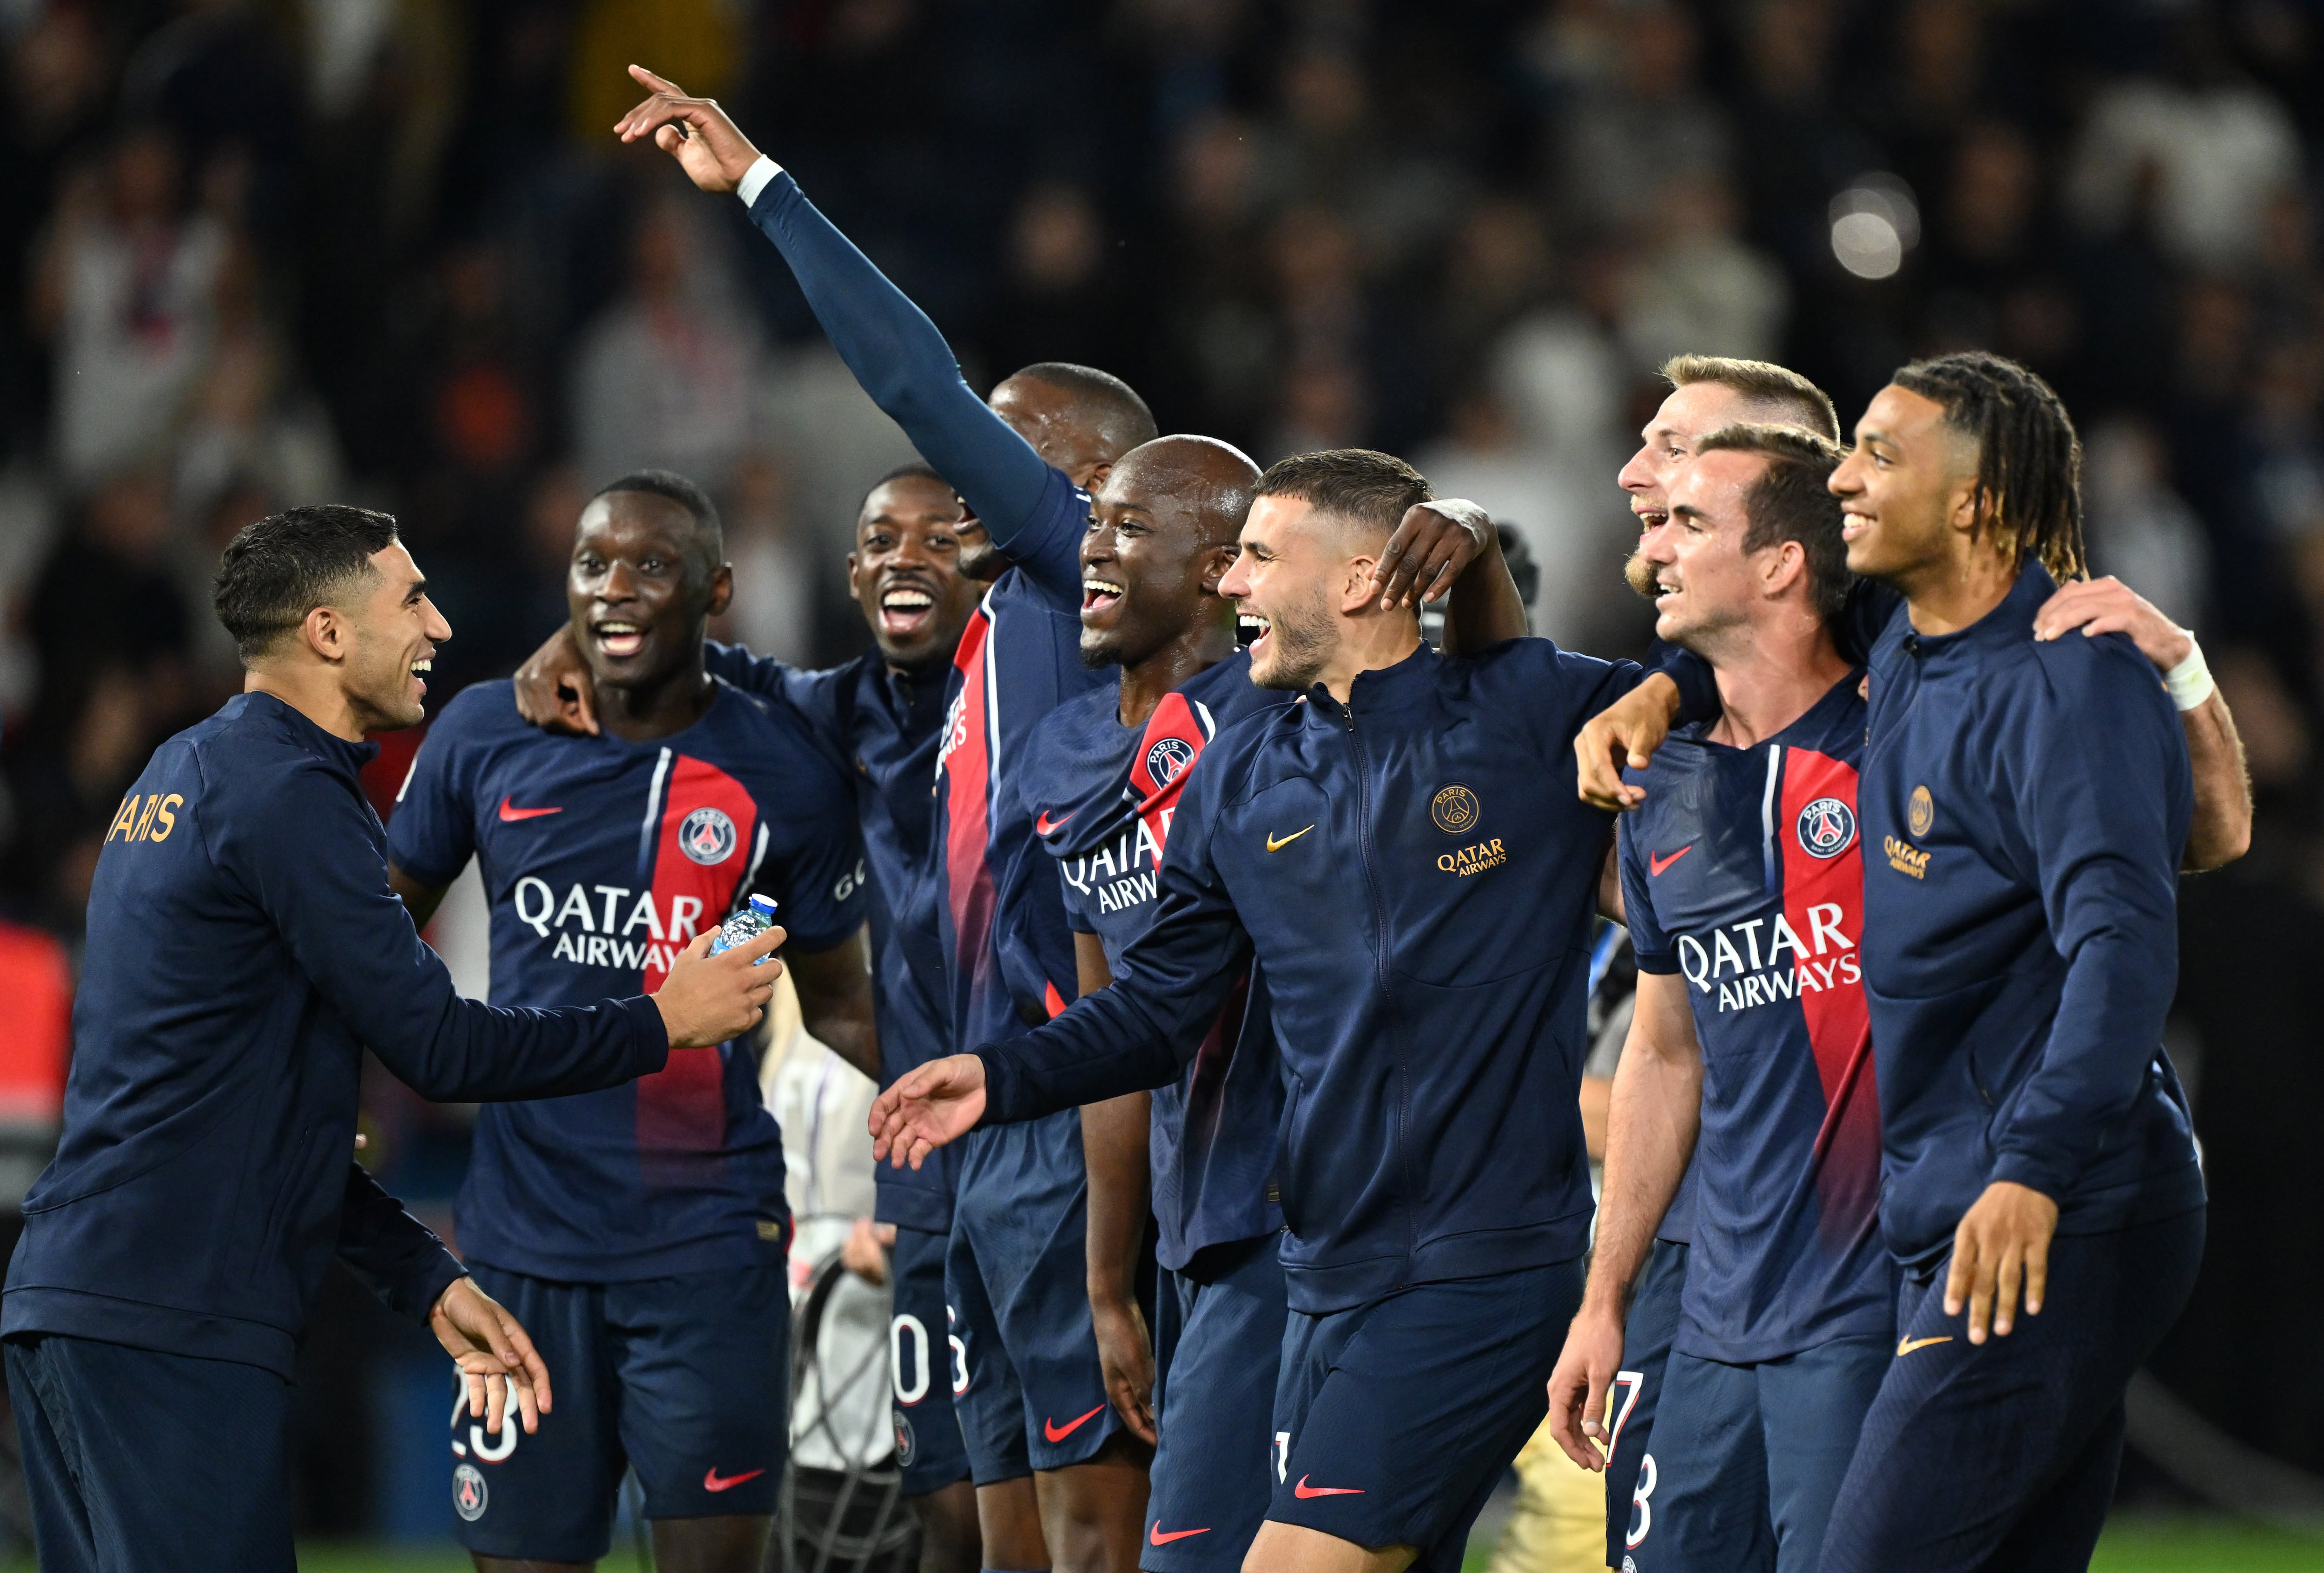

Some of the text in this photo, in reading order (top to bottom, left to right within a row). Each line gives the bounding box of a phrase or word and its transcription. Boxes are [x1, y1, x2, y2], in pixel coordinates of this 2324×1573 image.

[1150, 741, 1179, 763] PARIS
[1437, 789, 1466, 804] PARIS
[1804, 801, 1842, 820] PARIS
[1437, 838, 1505, 872] QATAR
[1459, 853, 1506, 878] AIRWAYS
[514, 876, 703, 942] QATAR
[1678, 902, 1855, 994] QATAR
[1719, 953, 1861, 1013] AIRWAYS
[1606, 1371, 1644, 1468] 7
